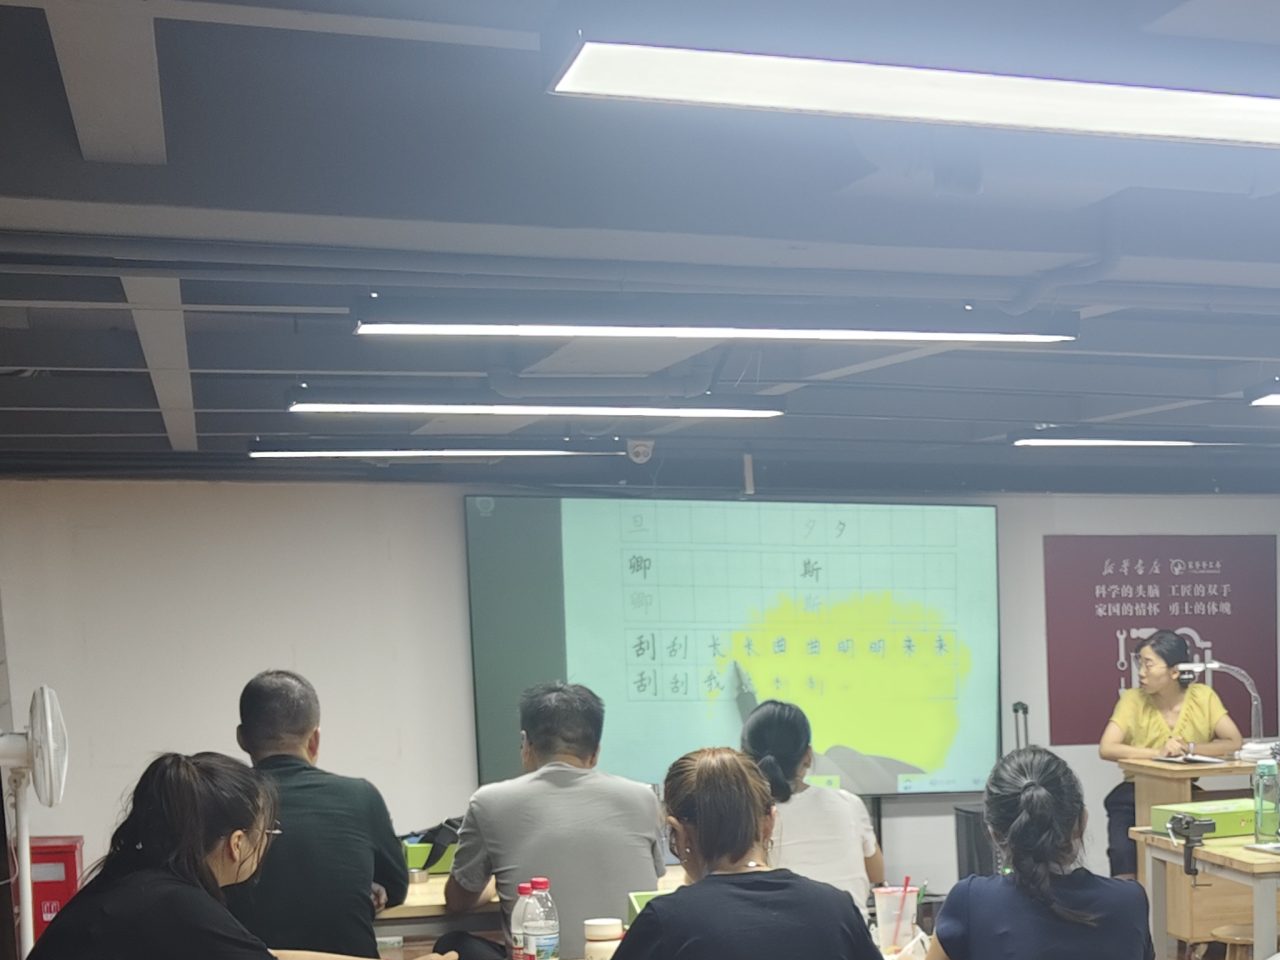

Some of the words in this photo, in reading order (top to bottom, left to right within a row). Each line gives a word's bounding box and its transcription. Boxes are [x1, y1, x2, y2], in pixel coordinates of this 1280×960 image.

[1095, 584, 1160, 598] 科学的头脑
[1168, 583, 1232, 597] 工匠的双手
